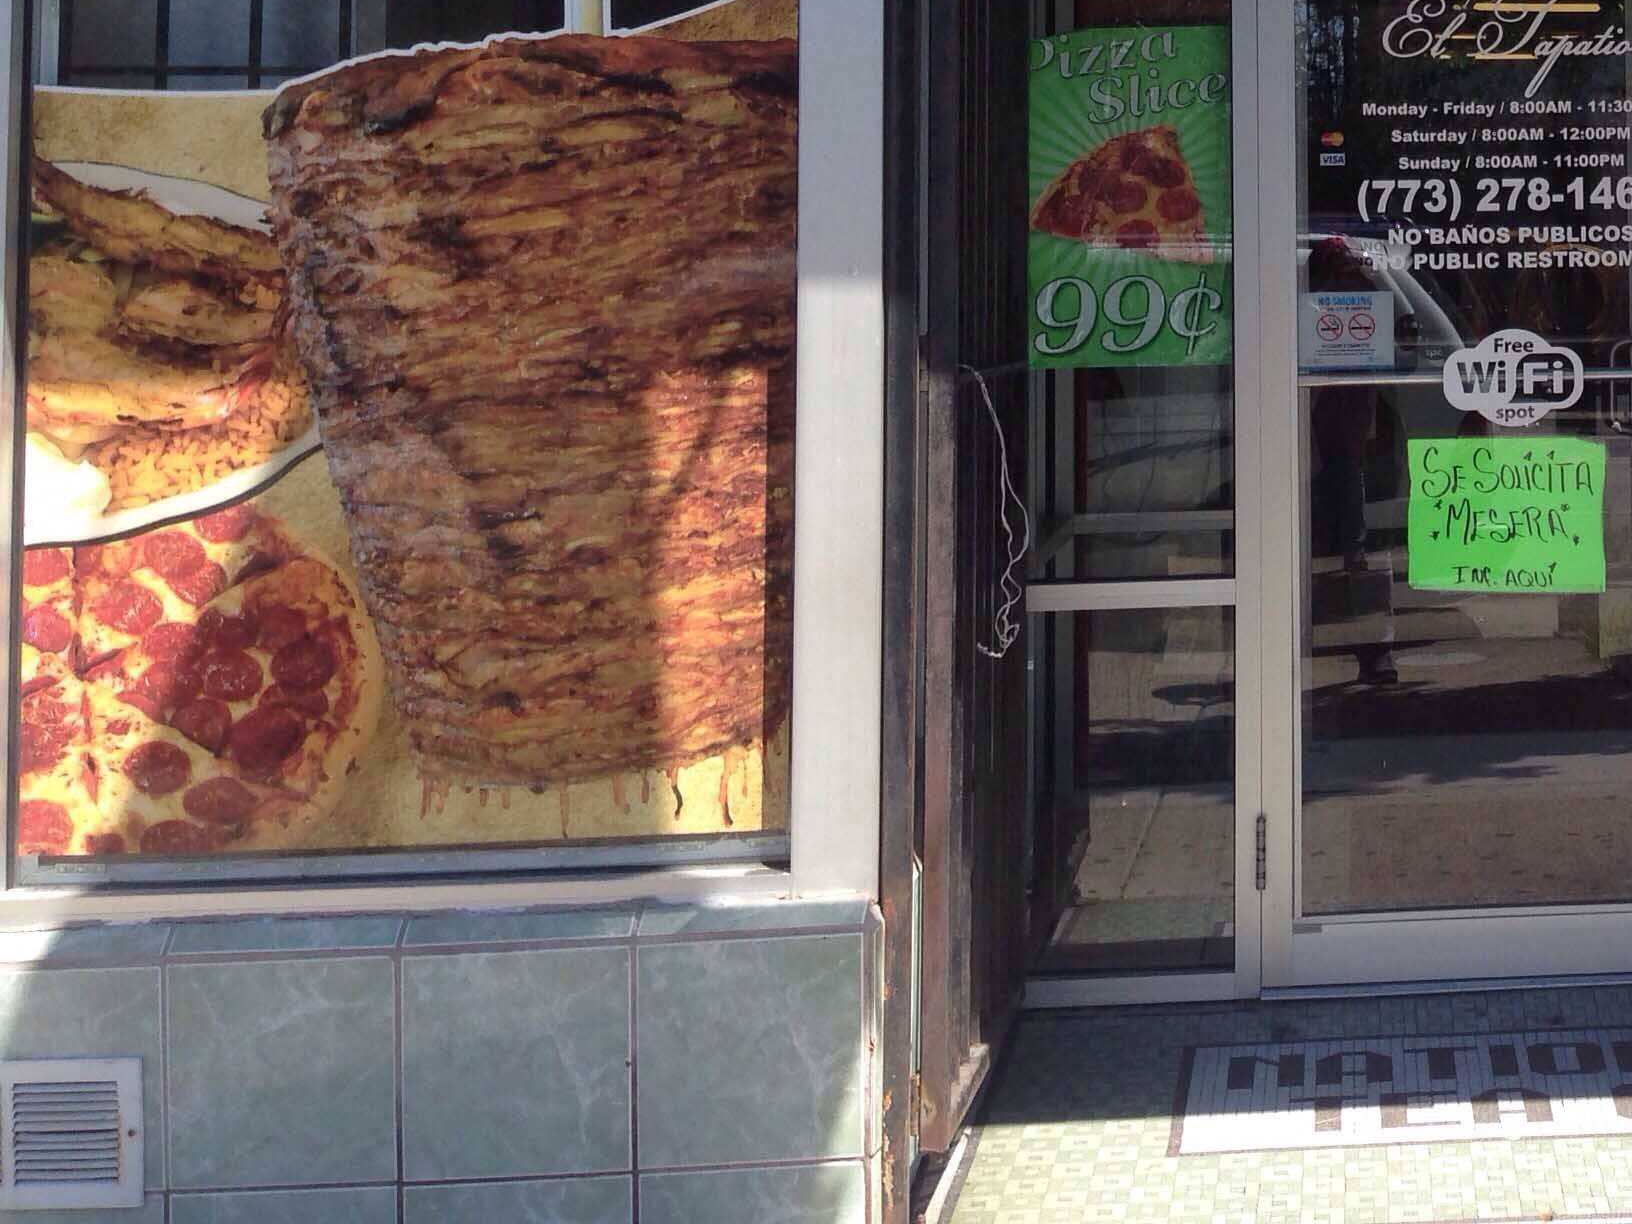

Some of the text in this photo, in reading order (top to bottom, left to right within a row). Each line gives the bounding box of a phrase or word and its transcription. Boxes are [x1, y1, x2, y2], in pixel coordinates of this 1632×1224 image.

[1087, 69, 1227, 124] Slice
[1362, 102, 1428, 117] Monday
[1443, 101, 1495, 116] Friday
[1509, 101, 1572, 114] 8:00AM
[1391, 129, 1467, 144] Saturday
[1481, 129, 1544, 142] 8:00AM
[1559, 127, 1631, 141] 12:00PM
[1398, 157, 1461, 171] Sunday
[1475, 156, 1538, 169] 8:00AM
[1553, 154, 1625, 168] 11:00PM
[1357, 179, 1462, 222] (773)
[1388, 229, 1422, 246] NO
[1430, 224, 1510, 245] BAÑOS
[1372, 254, 1406, 271] NO
[1414, 253, 1499, 270] PUBLIC
[1033, 272, 1223, 356] 99¢
[1493, 338, 1534, 353] Free
[1496, 405, 1535, 422] spot
[1421, 447, 1466, 498] SE
[1288, 1088, 1554, 1132] TEA
